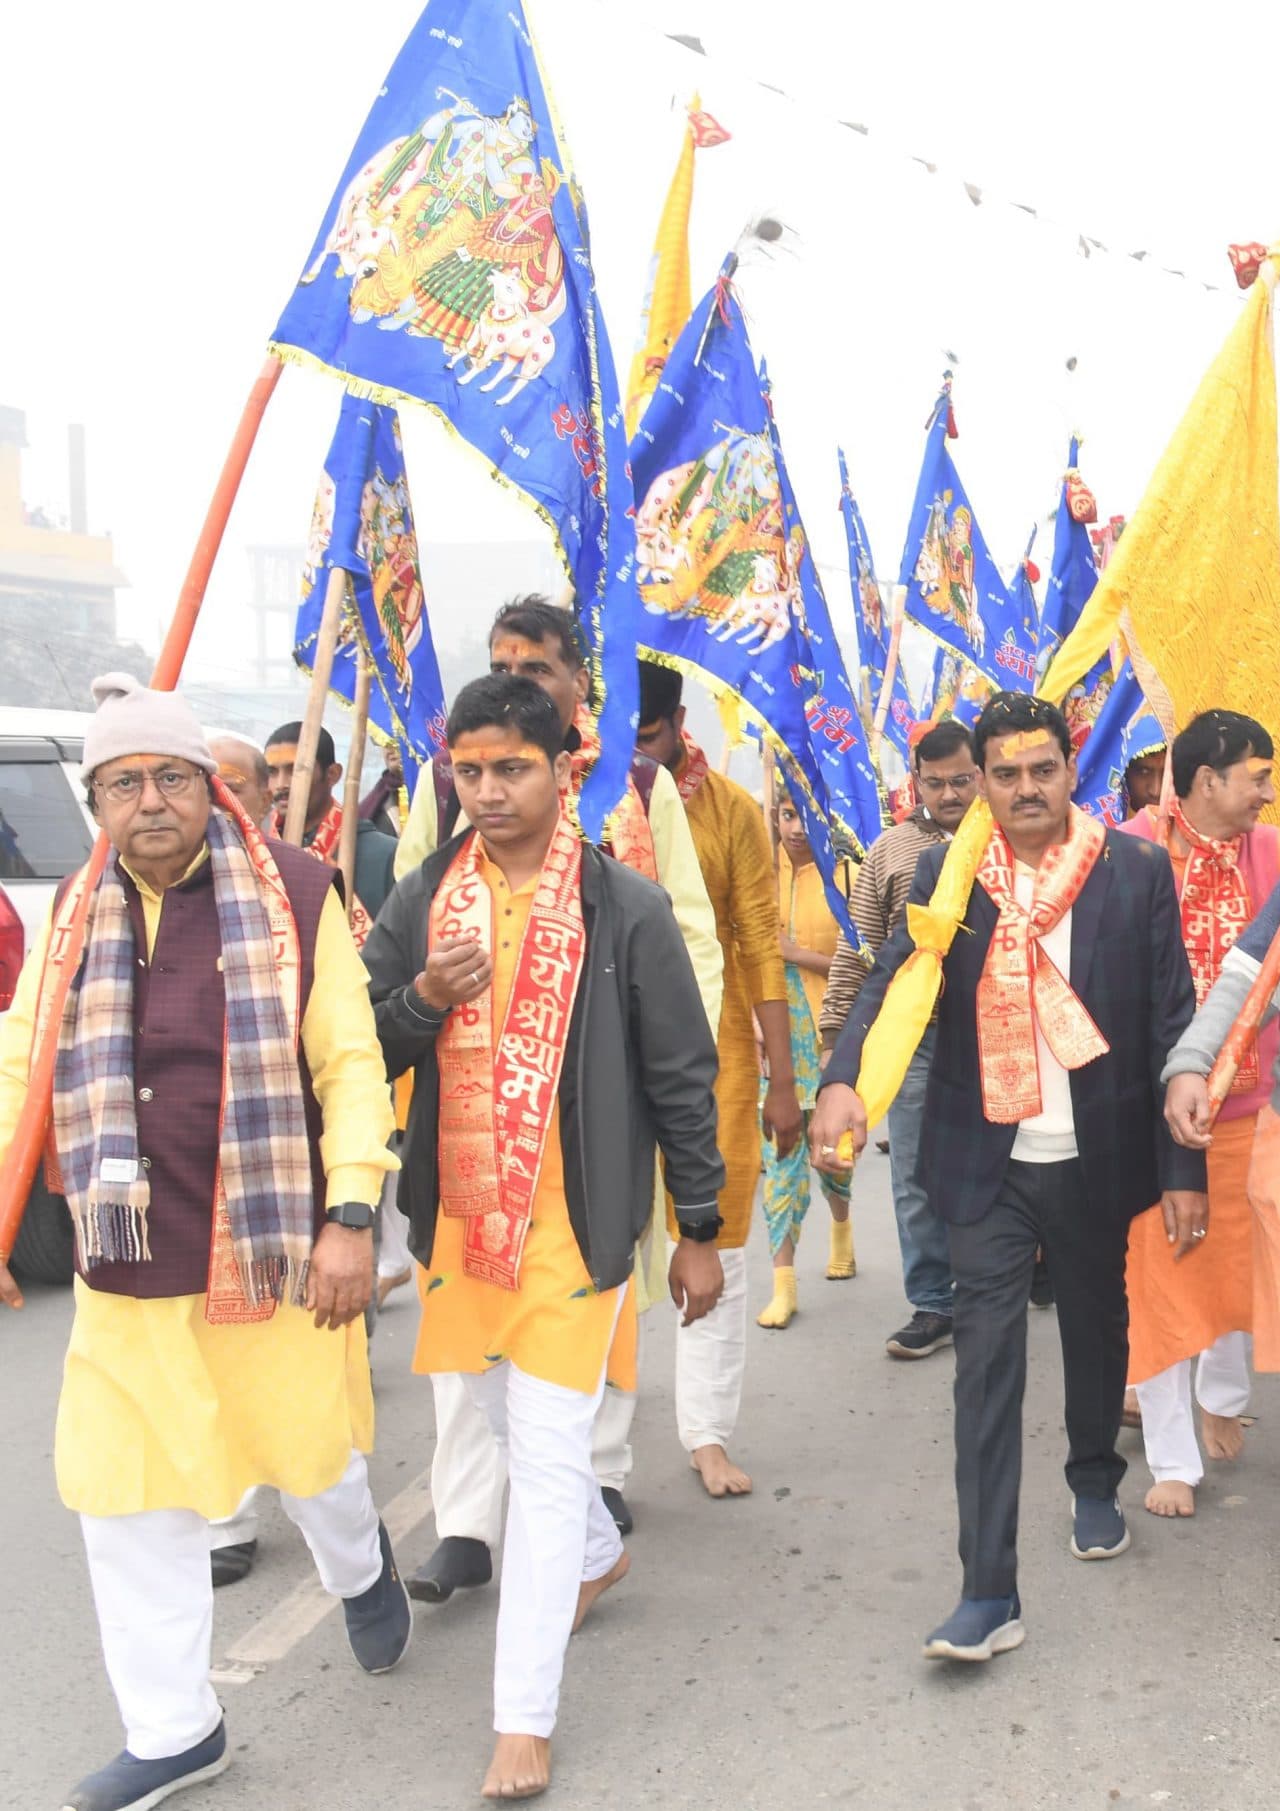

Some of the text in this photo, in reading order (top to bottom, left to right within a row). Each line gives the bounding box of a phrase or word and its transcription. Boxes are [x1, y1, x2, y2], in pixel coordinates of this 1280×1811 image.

[530, 918, 578, 1003] जय
[513, 994, 563, 1045] श्री
[500, 1031, 561, 1114] श्याम
